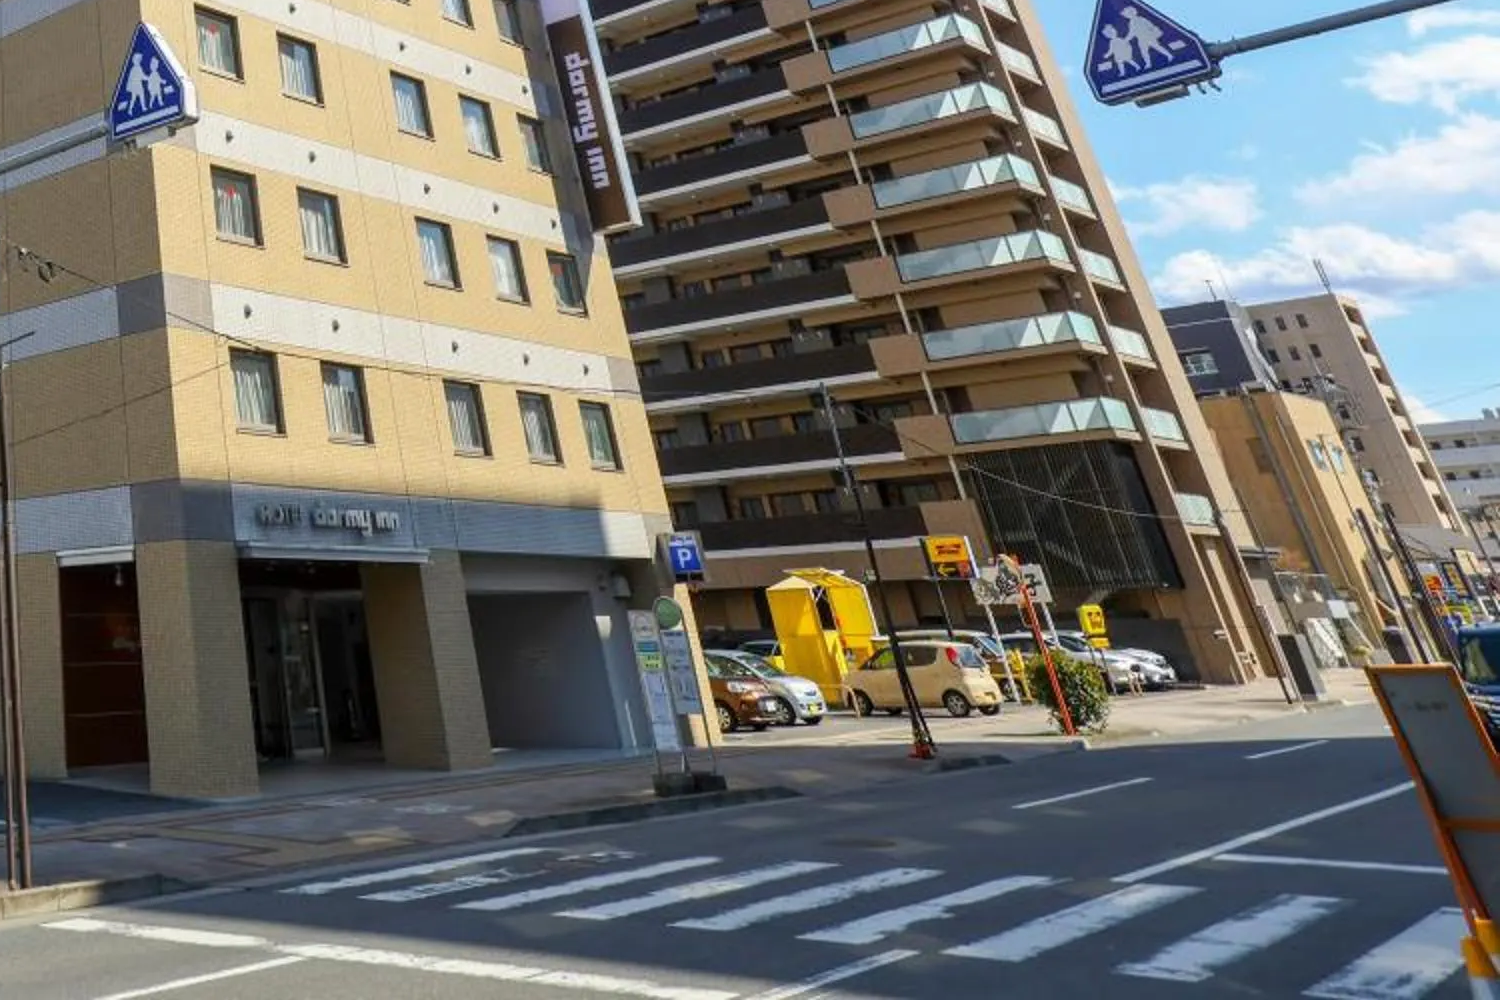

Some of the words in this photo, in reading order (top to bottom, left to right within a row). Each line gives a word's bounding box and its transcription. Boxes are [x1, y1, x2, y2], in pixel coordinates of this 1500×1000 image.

[564, 51, 599, 144] dormy
[585, 146, 610, 189] inn
[676, 548, 692, 569] P
